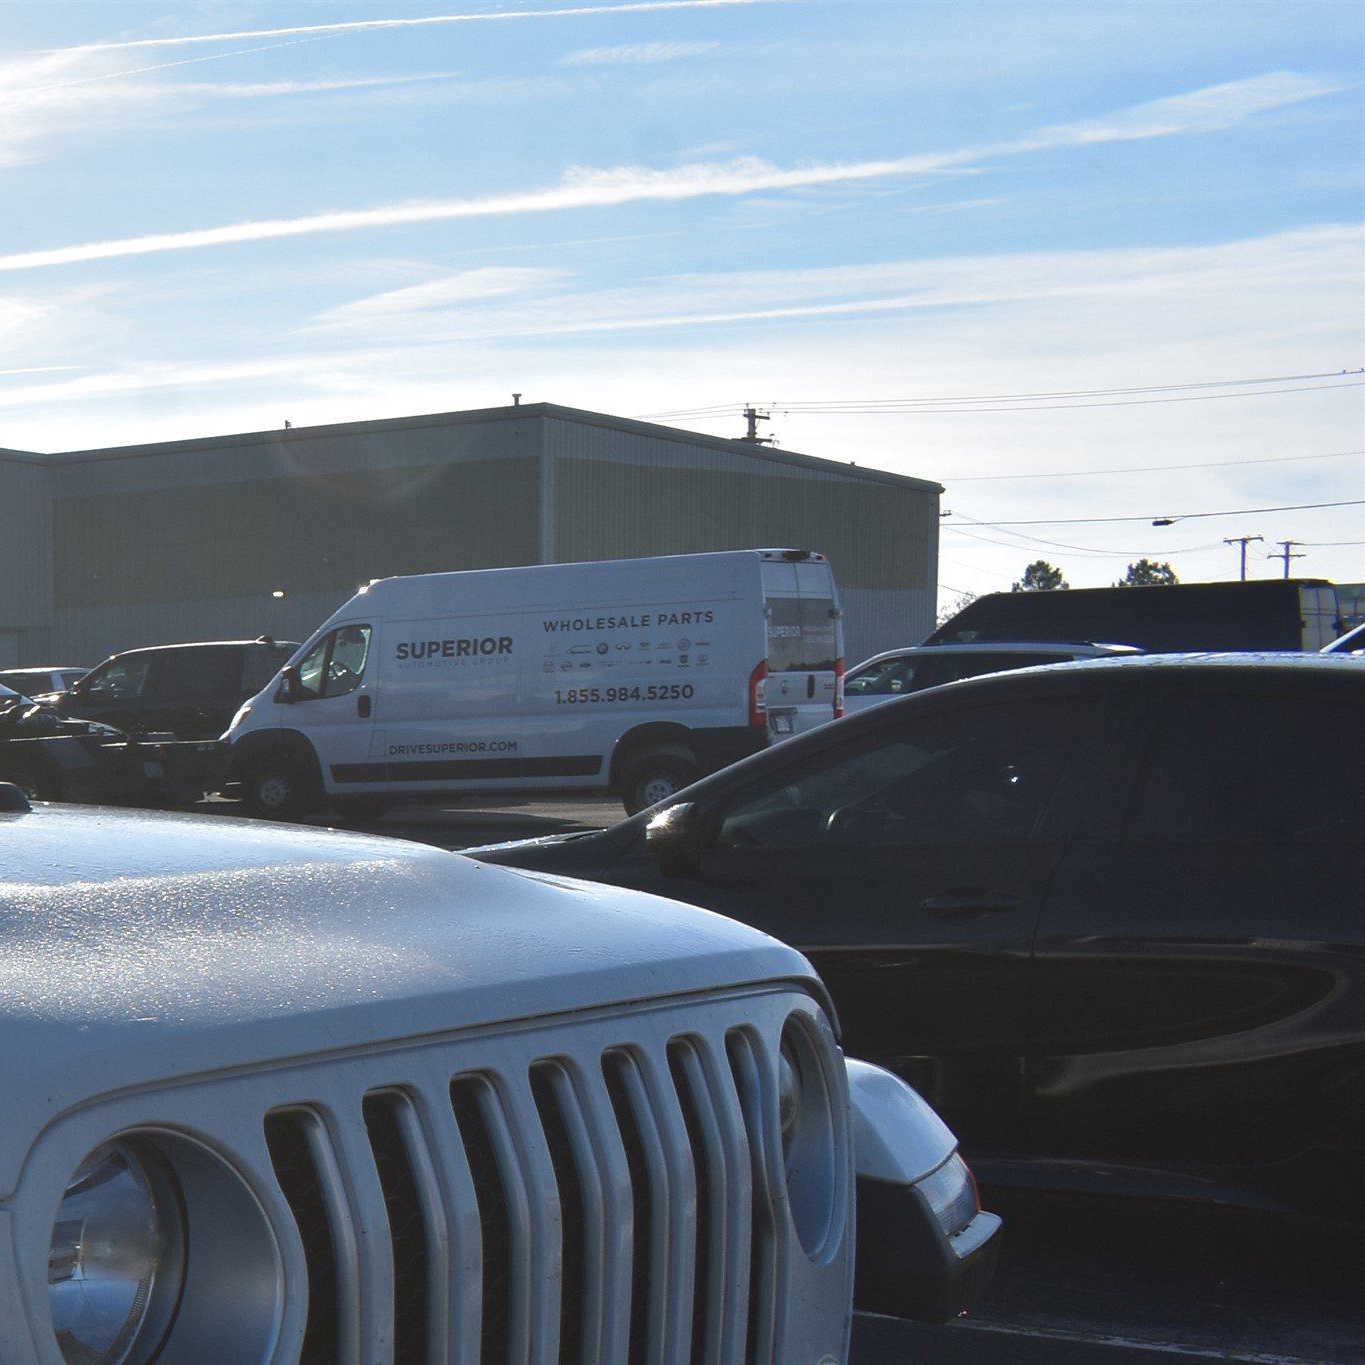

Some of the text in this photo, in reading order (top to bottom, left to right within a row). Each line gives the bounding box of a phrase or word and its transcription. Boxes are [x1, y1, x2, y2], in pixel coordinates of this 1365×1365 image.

[543, 611, 714, 633] WHOLESALE PARTS
[395, 636, 514, 660] SUPERIOR
[397, 656, 510, 670] AUTOMOTIVE GROUP
[554, 684, 694, 704] 1.855.984.5250
[389, 741, 517, 755] DRIVESUPERIOR.COM
